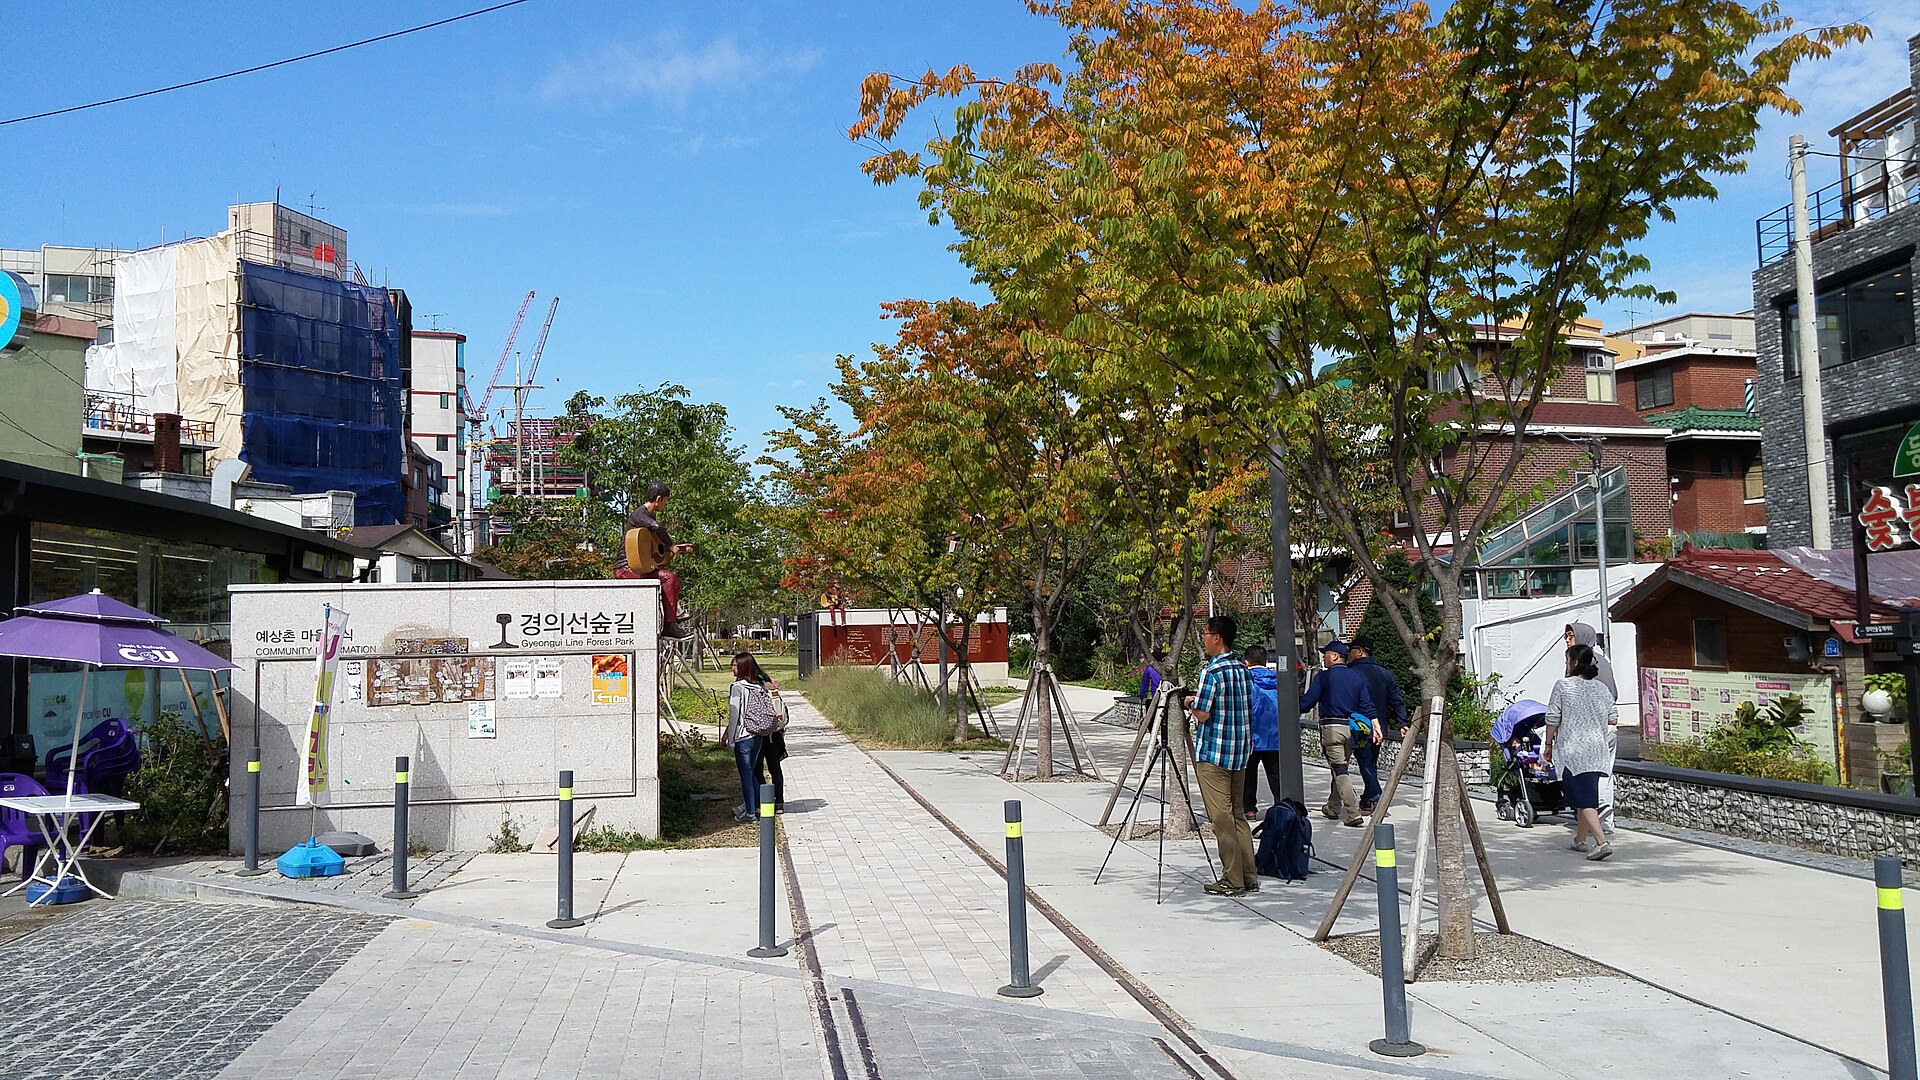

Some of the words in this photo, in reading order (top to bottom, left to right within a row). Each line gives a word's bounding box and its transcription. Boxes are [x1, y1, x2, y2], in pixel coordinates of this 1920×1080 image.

[520, 612, 635, 636] 경의선숲길
[255, 629, 296, 643] 예상촌
[301, 628, 354, 643] 마을식
[521, 639, 563, 649] Gyeongui
[565, 638, 584, 647] Line
[586, 637, 613, 646] Forest
[615, 637, 635, 646] Park
[255, 646, 313, 656] COMMUNITY
[179, 701, 188, 711] CU
[102, 707, 112, 718] CU
